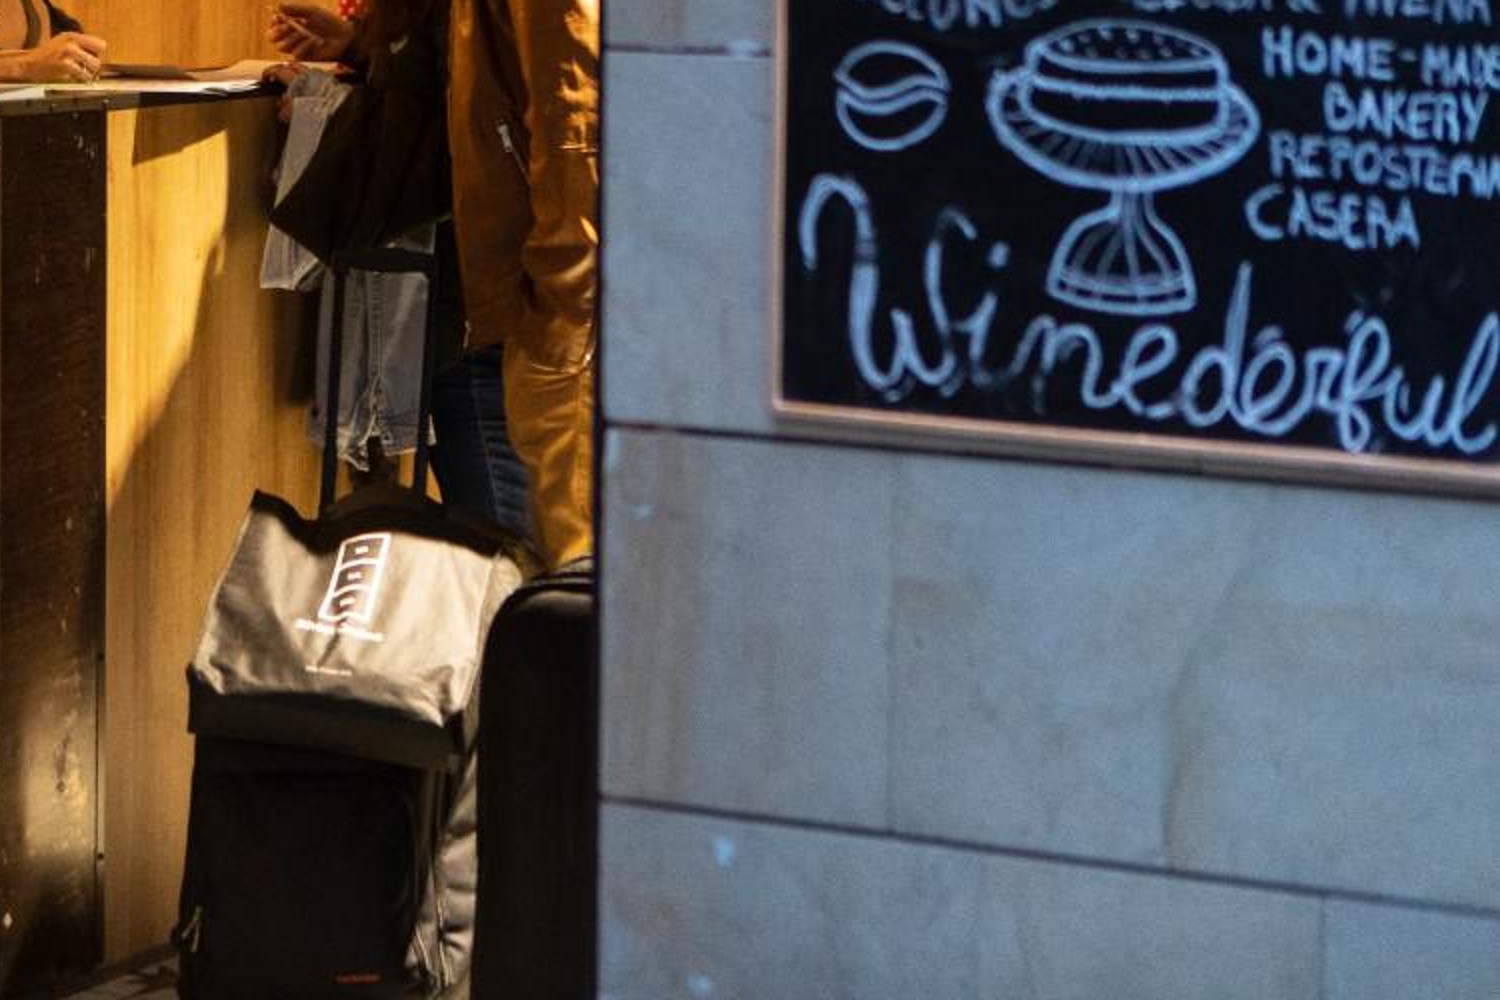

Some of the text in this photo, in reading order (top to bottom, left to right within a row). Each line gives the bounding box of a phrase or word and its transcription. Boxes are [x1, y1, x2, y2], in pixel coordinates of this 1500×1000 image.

[1322, 81, 1489, 145] BAKERY
[1245, 183, 1421, 249] CASERA
[800, 174, 1499, 454] Winederful
